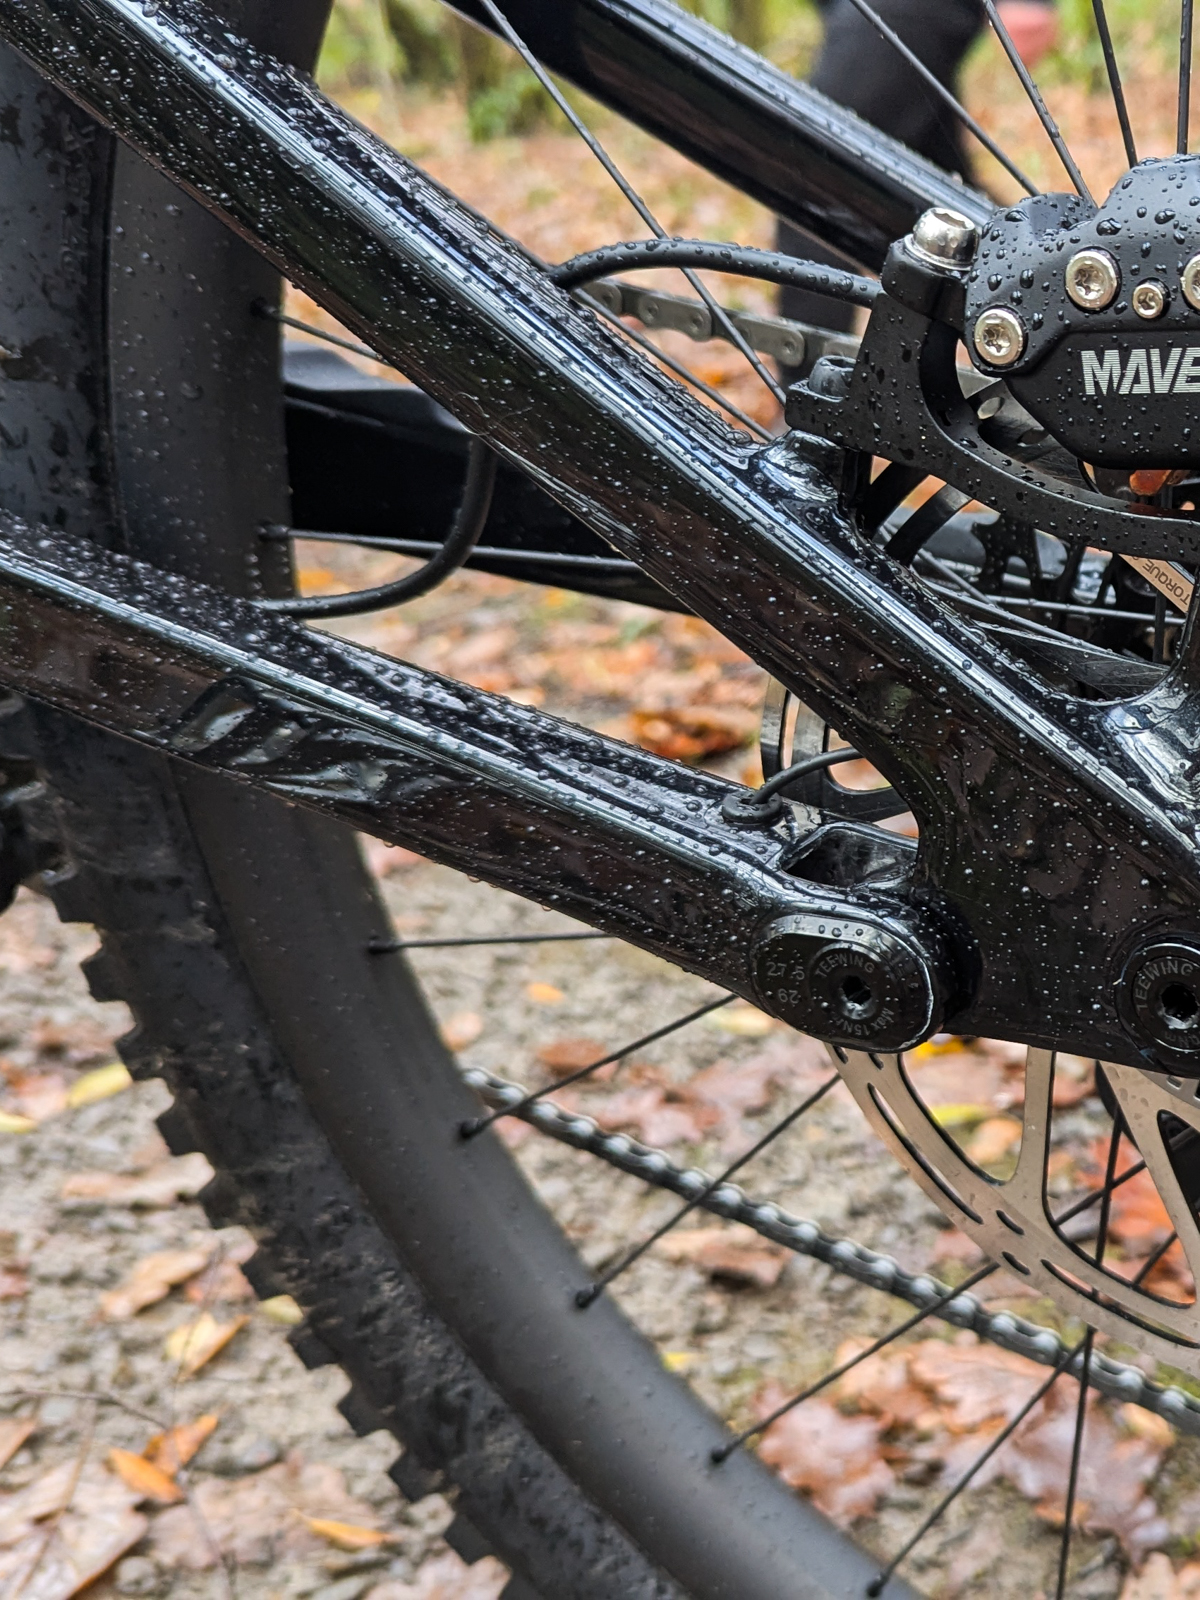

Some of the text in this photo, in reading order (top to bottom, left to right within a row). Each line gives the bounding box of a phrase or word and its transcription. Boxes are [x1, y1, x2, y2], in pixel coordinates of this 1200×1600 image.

[1142, 558, 1191, 606] TORQUE
[815, 952, 875, 978] TEEWING
[1135, 960, 1194, 1012] TEEWING
